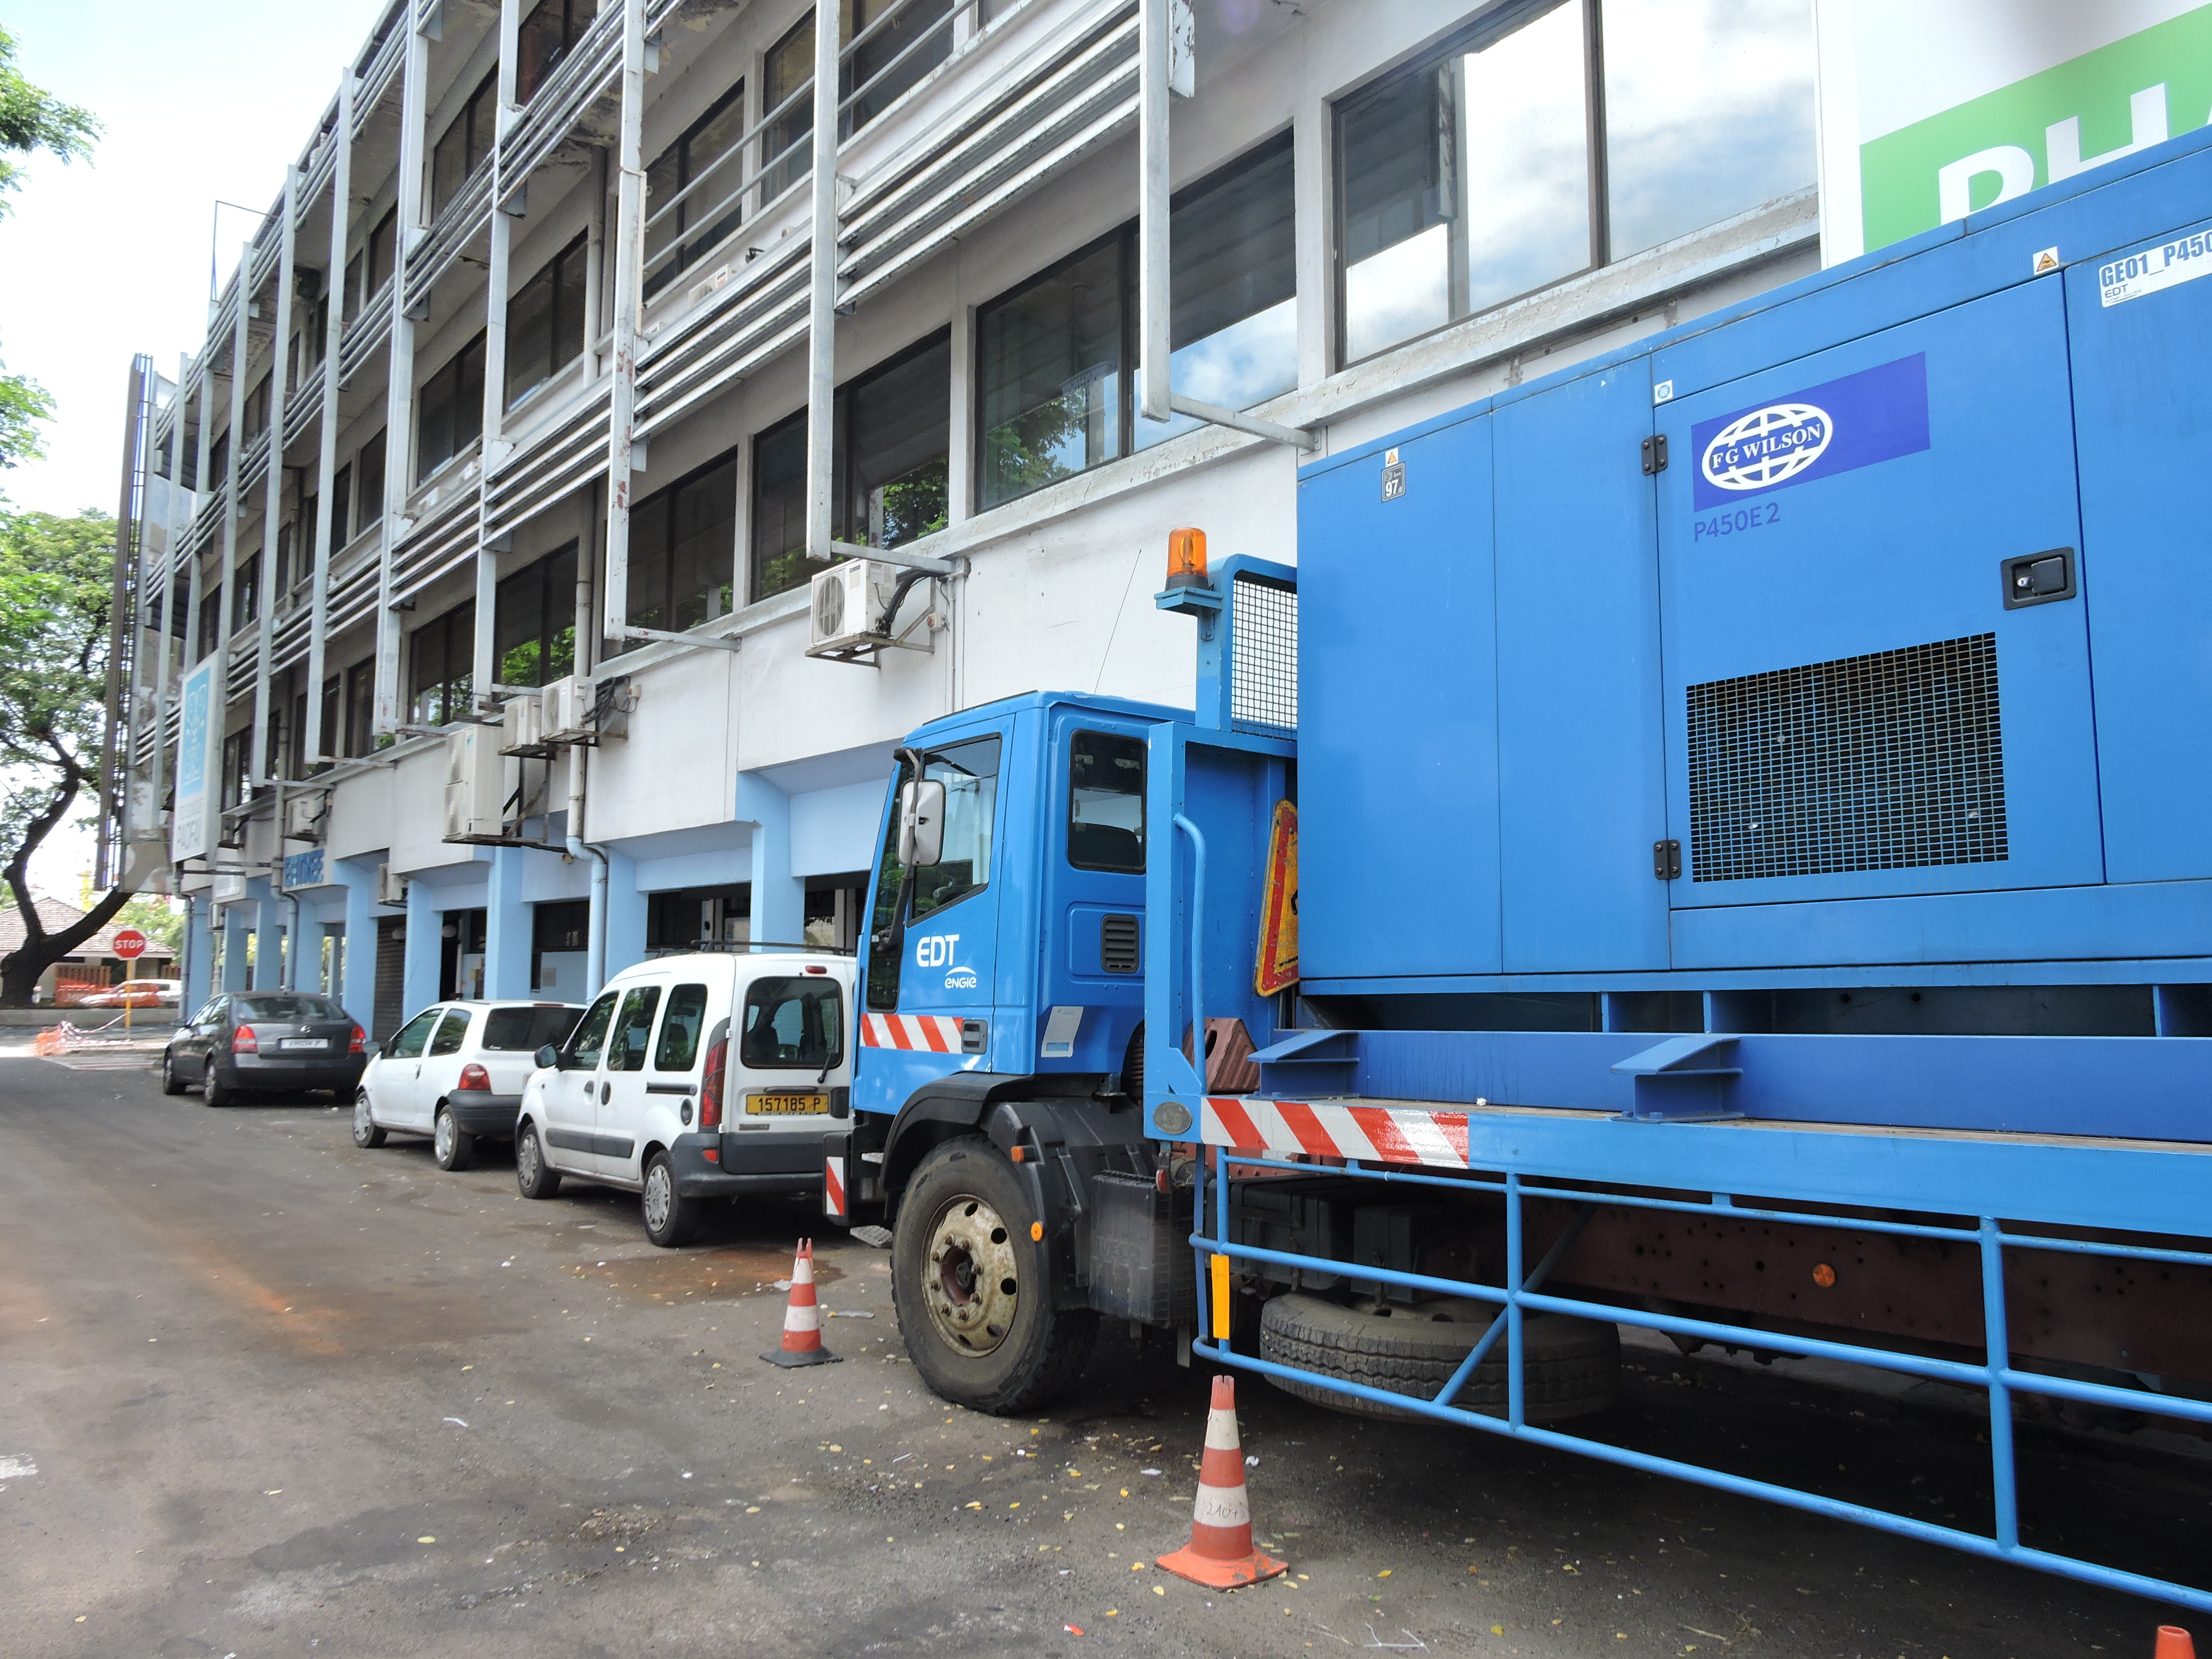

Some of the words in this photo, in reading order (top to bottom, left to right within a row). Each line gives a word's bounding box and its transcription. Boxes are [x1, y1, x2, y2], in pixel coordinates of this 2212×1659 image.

[1938, 83, 2212, 226] PH
[2105, 284, 2128, 298] EDT
[1712, 448, 1739, 469] FG
[1743, 423, 1821, 458] WILSON
[1385, 479, 1399, 497] 97
[1694, 502, 1780, 542] P450E2
[115, 939, 144, 949] STOP
[916, 934, 960, 967] EDT
[759, 1097, 805, 1111] 157185
[813, 1097, 820, 1111] P
